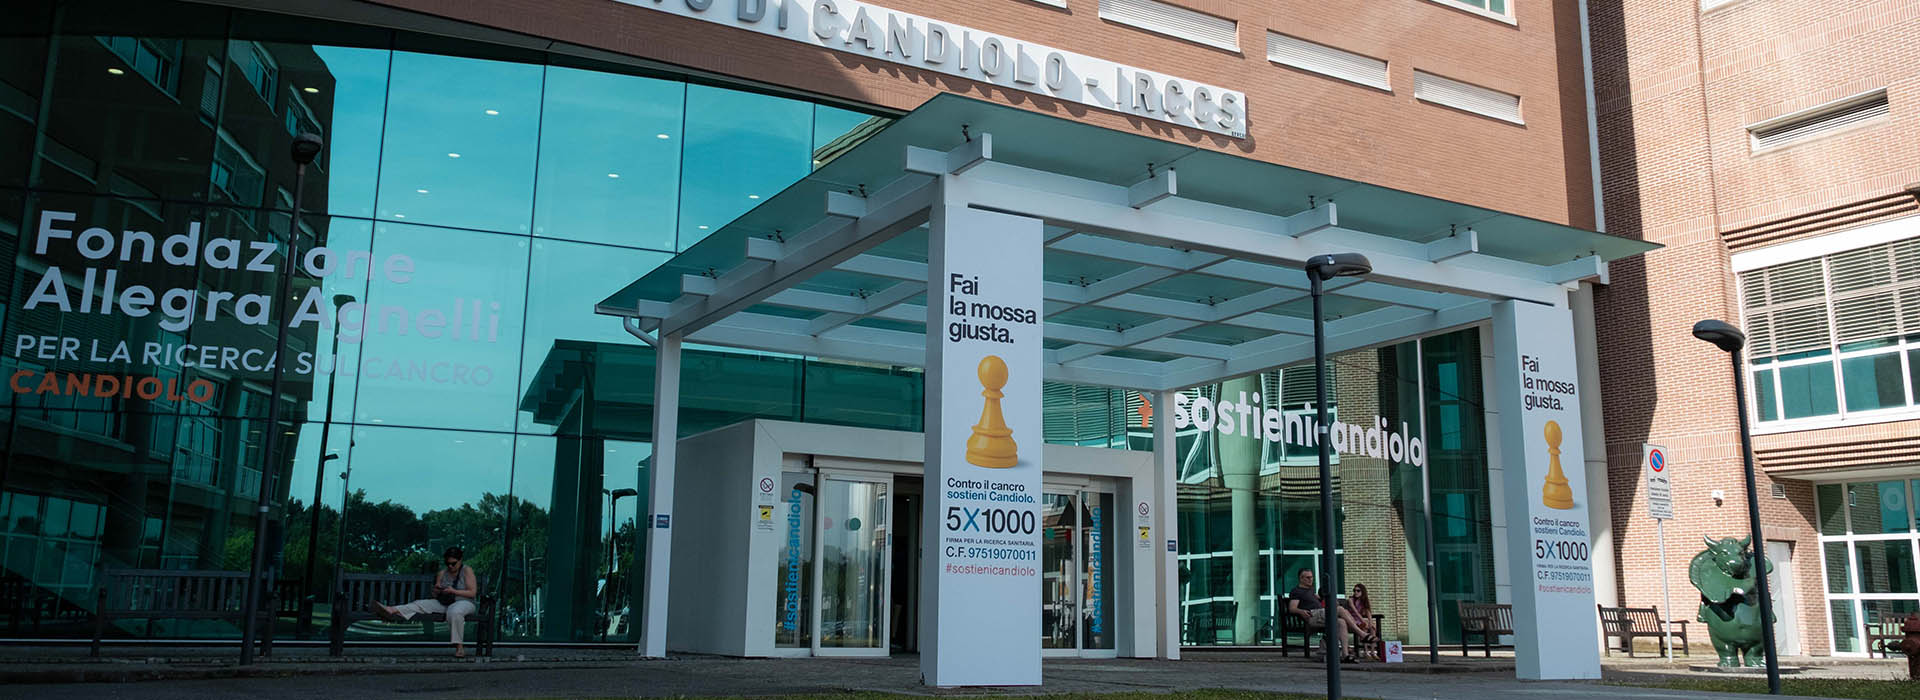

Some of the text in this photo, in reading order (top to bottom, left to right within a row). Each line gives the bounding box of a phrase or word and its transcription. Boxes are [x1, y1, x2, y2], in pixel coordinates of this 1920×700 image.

[811, 0, 1067, 90] CANDIOLO
[1115, 67, 1239, 129] IRCCS
[950, 273, 978, 296] Fai
[23, 266, 501, 344] Allegra Agnelli
[950, 295, 1037, 324] la mossa
[949, 318, 1015, 344] giusta.
[15, 334, 80, 360] PER
[90, 339, 132, 364] LA
[295, 351, 355, 377] SUL
[363, 357, 494, 386] CANCRO
[1522, 355, 1539, 372] Fai
[10, 370, 215, 403] CANDIOLO
[1523, 373, 1576, 395] la mossa
[1524, 391, 1564, 411] giusta.
[947, 477, 1025, 492] Contro il cancro
[947, 490, 1036, 504] sostieni Candiolo.
[946, 506, 1036, 535] 5X1000
[1533, 516, 1555, 526] Contro
[1560, 519, 1580, 528] cancro
[1534, 526, 1558, 535] sostieni
[964, 537, 974, 545] PER
[1536, 539, 1588, 561] 5X1000
[784, 488, 802, 631] #sostienicandiolo
[946, 546, 1036, 561] C.F. 97519070011
[946, 562, 1036, 577] #sostienicandiolo
